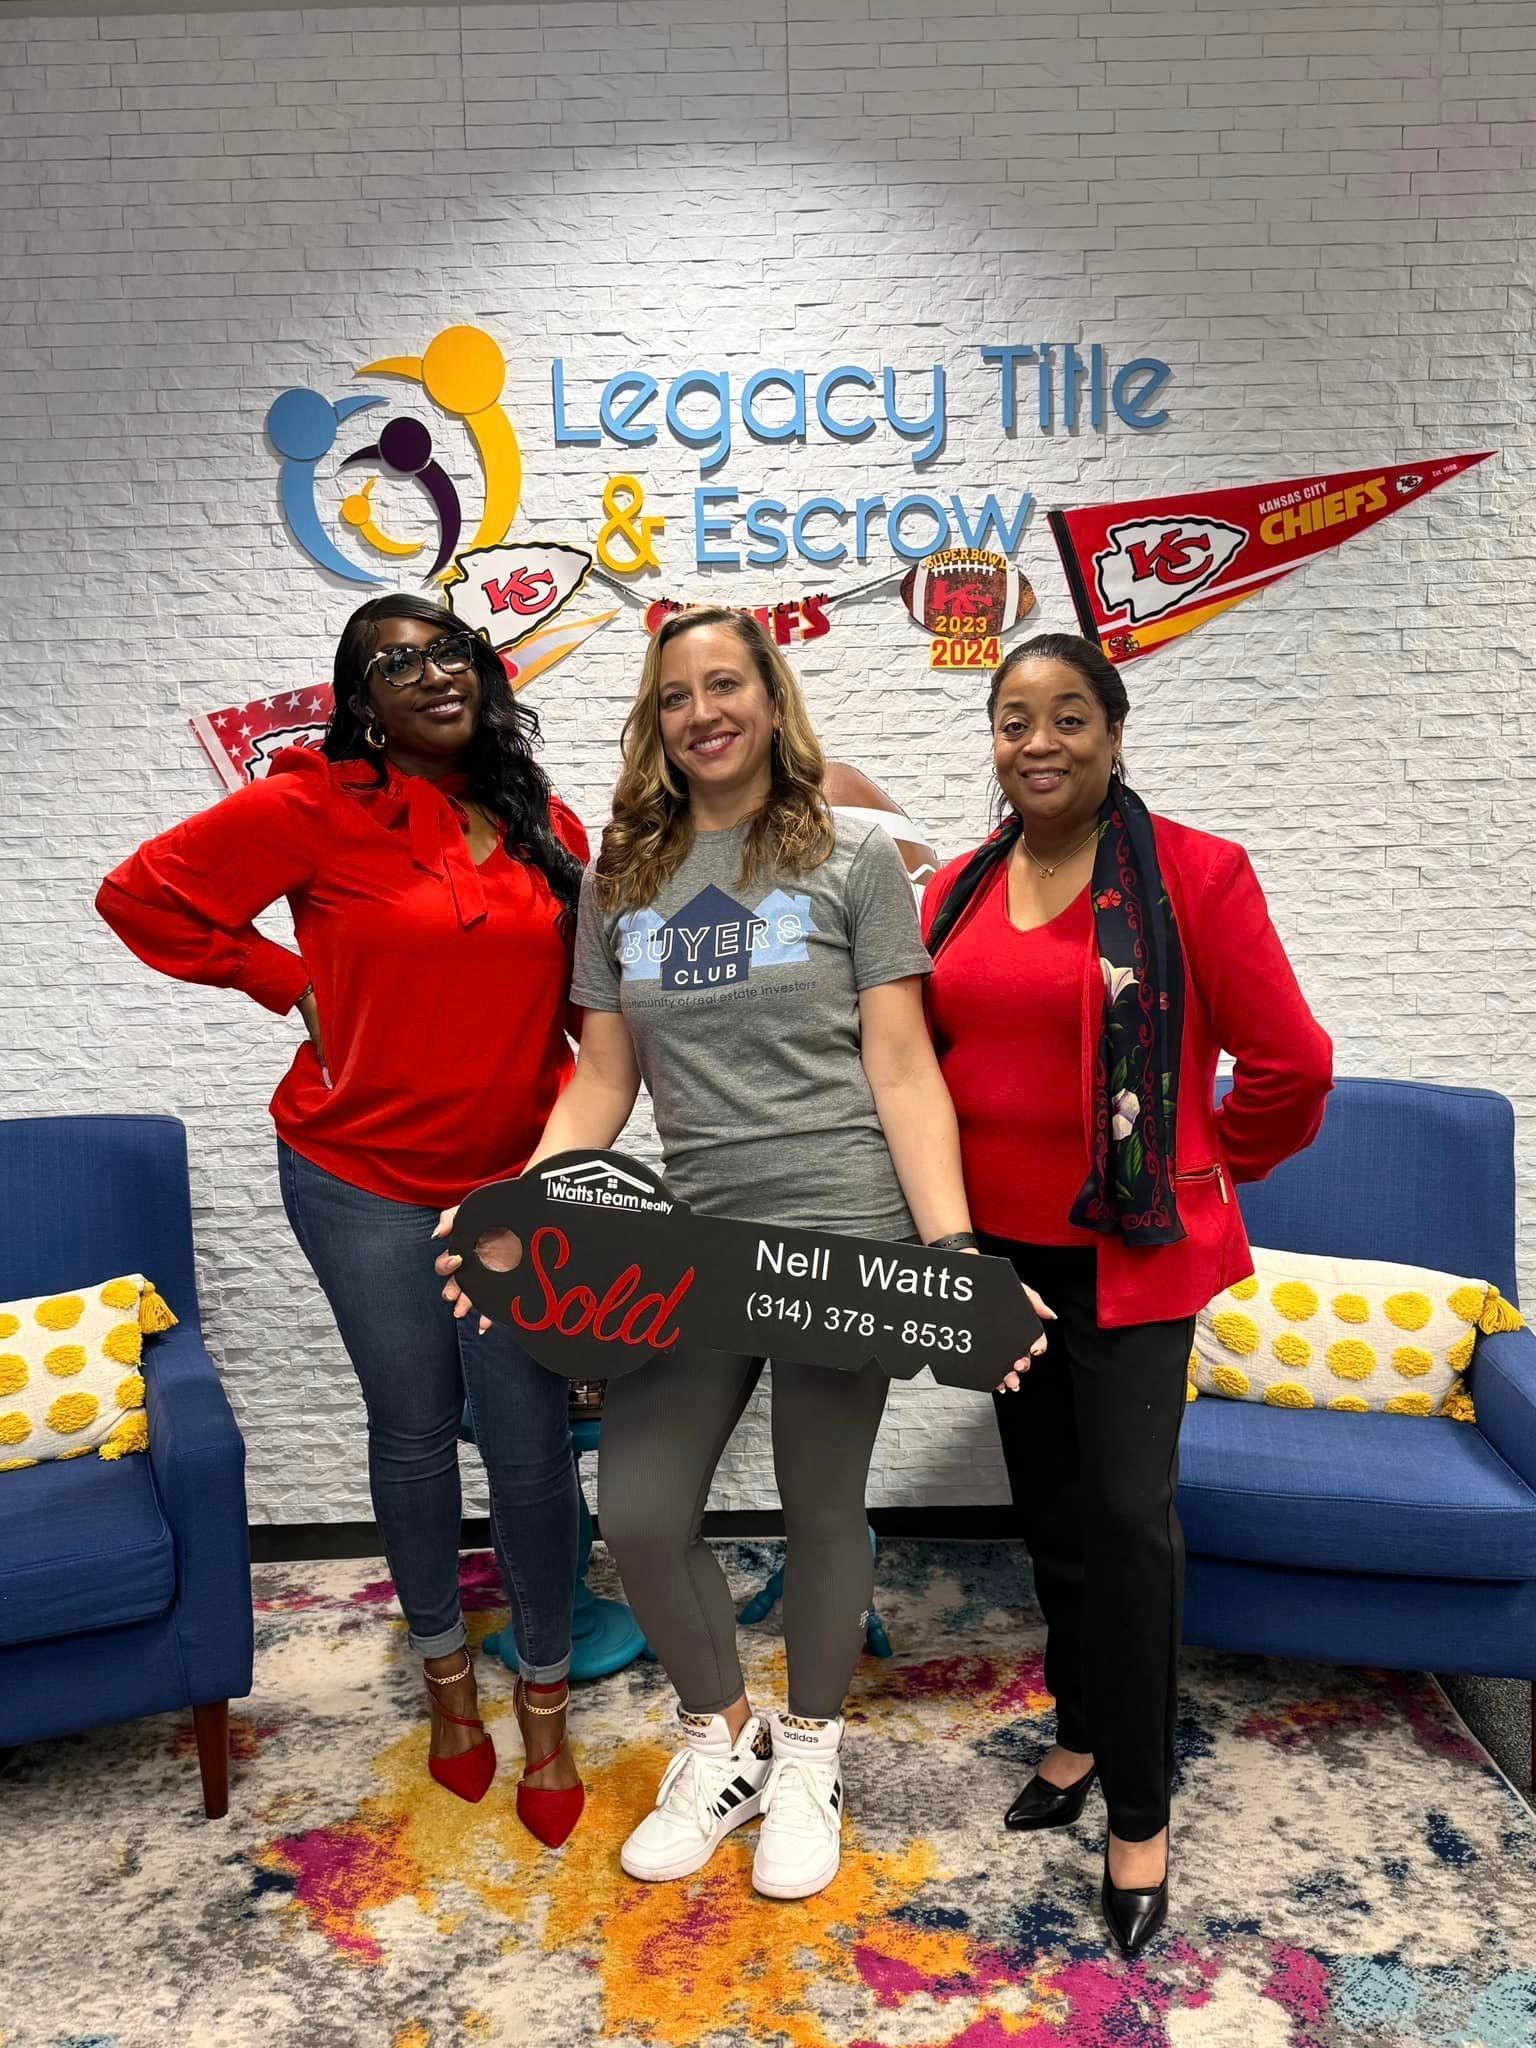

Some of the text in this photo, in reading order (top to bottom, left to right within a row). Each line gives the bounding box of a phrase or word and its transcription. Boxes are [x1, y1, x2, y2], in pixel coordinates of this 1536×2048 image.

[552, 343, 1172, 471] Legacy Title
[1258, 480, 1328, 515] KANSAS CITY
[1259, 475, 1388, 546] CHIEFS
[597, 475, 1033, 575] & Escrow
[1126, 527, 1213, 585] KC
[481, 566, 558, 617] KC
[935, 615, 988, 633] 2023
[932, 637, 1000, 667] 2024
[623, 913, 803, 964] BUYERS
[622, 995, 680, 1009] mmunity
[719, 987, 757, 1003] estate
[674, 963, 737, 985] CLUB
[551, 1181, 673, 1215] Watts Team Realty
[511, 1226, 696, 1349] Sold
[755, 1239, 974, 1302] Nell Watts
[746, 1292, 812, 1330] (314)
[823, 1306, 875, 1337] 378
[901, 1320, 973, 1354] 8533
[682, 1726, 707, 1739] adas
[784, 1729, 820, 1744] adidas
